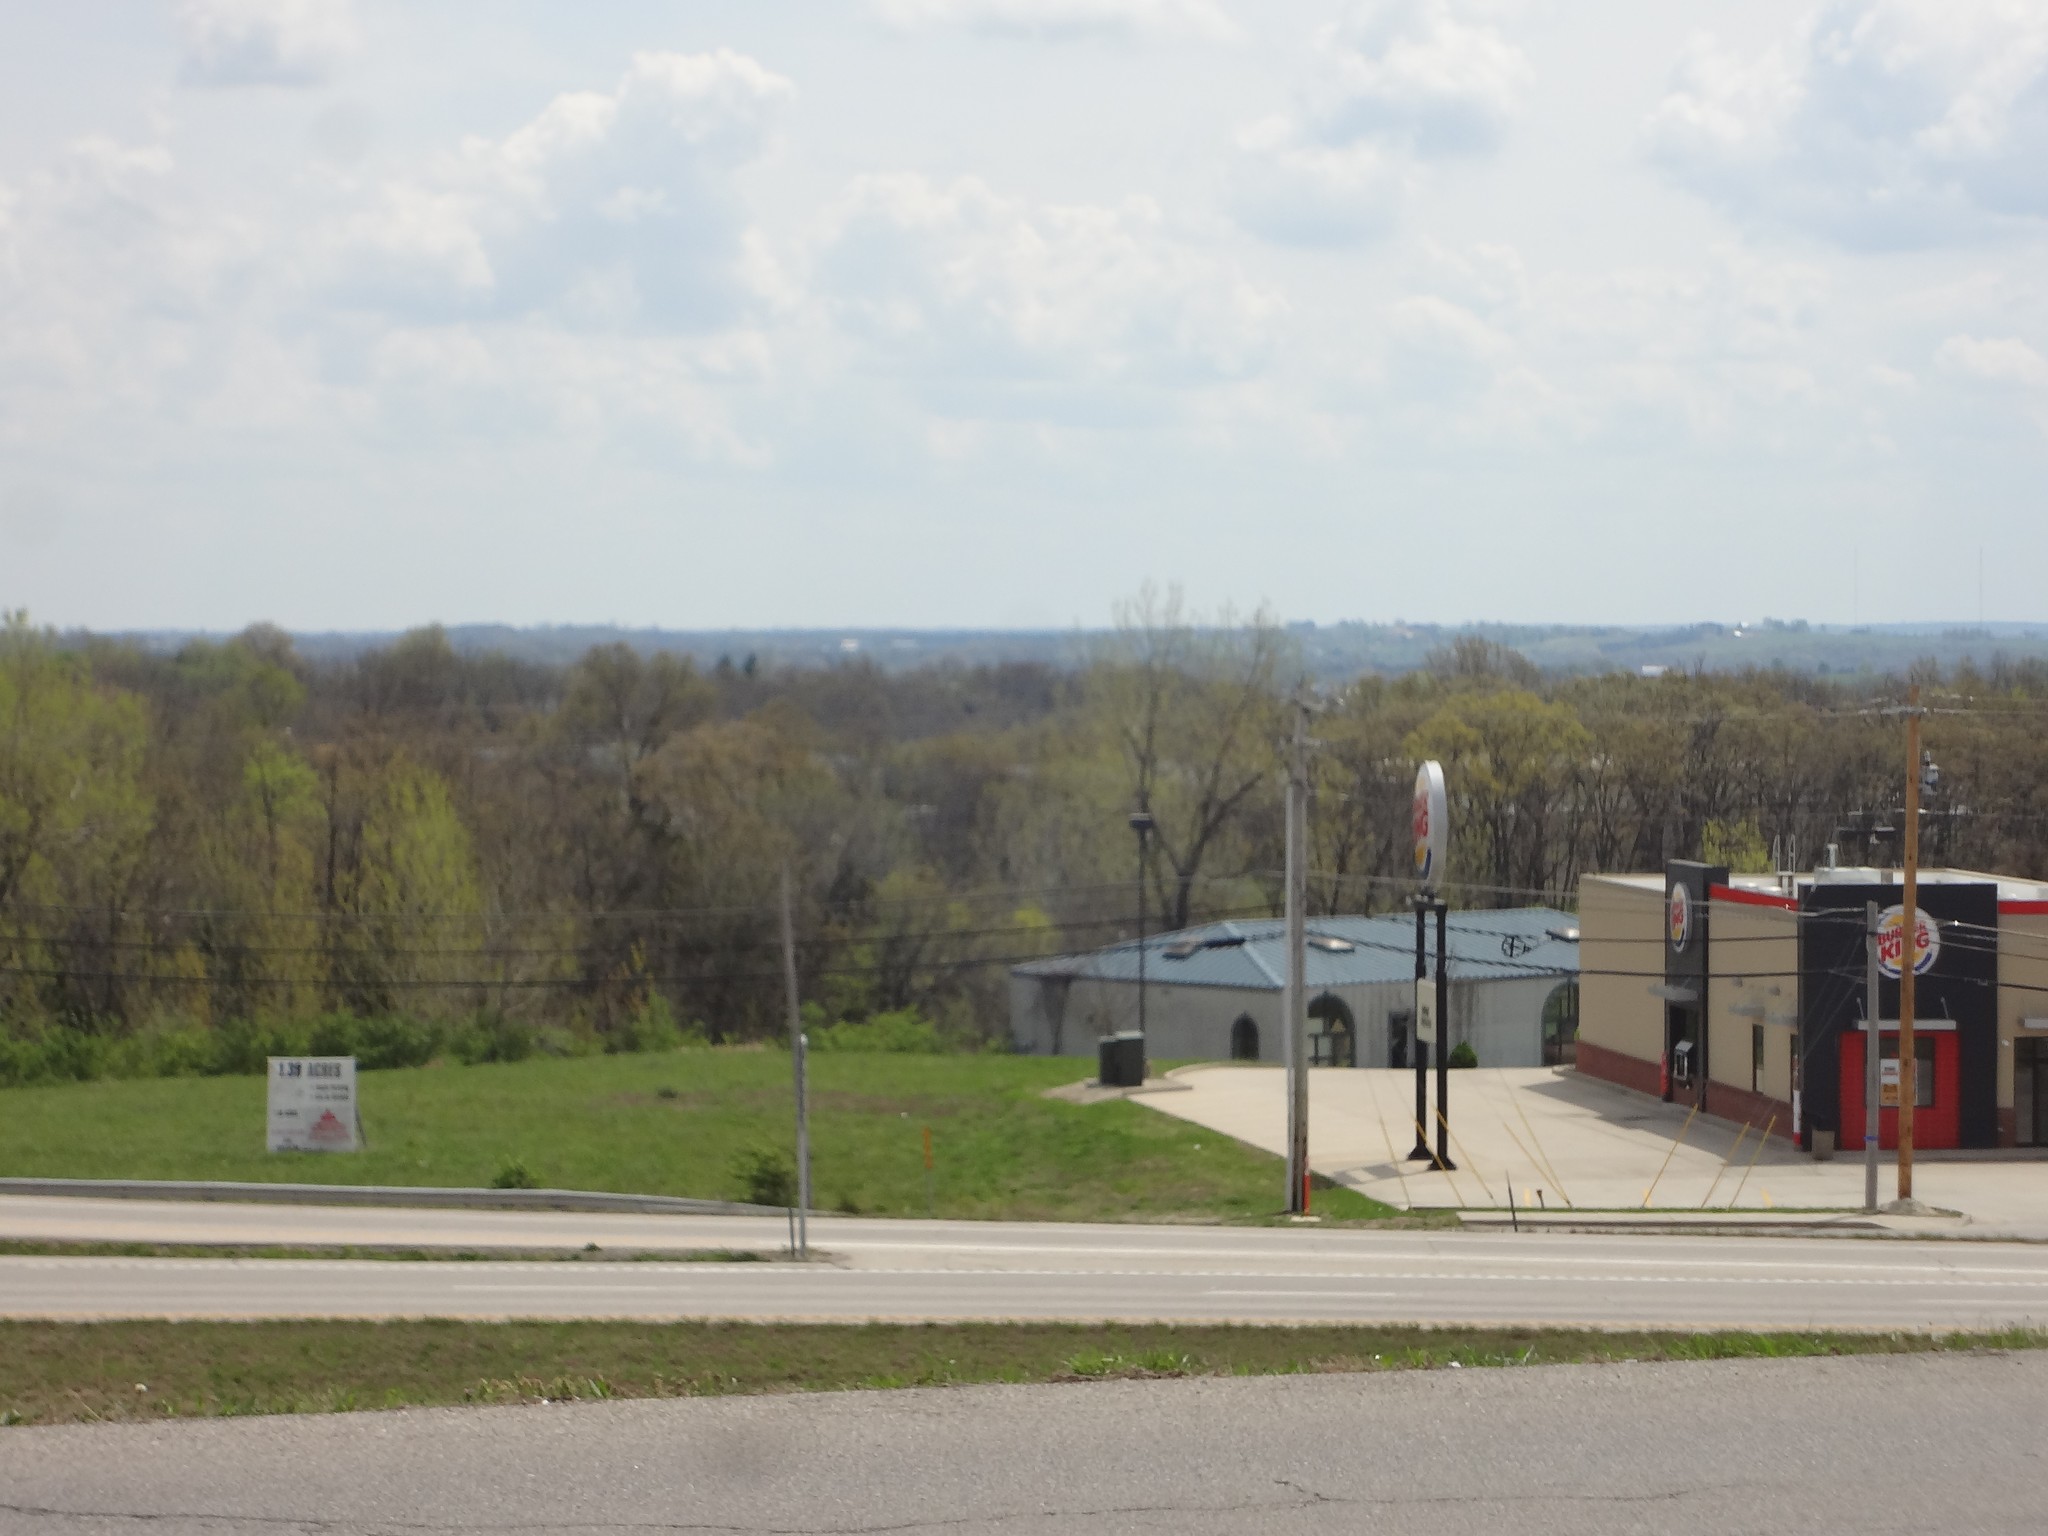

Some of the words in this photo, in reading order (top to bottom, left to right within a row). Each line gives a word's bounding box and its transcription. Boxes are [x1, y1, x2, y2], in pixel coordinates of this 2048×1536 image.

[1877, 922, 1927, 945] BURR
[1881, 932, 1929, 963] KIG
[307, 1062, 341, 1077] ACRES
